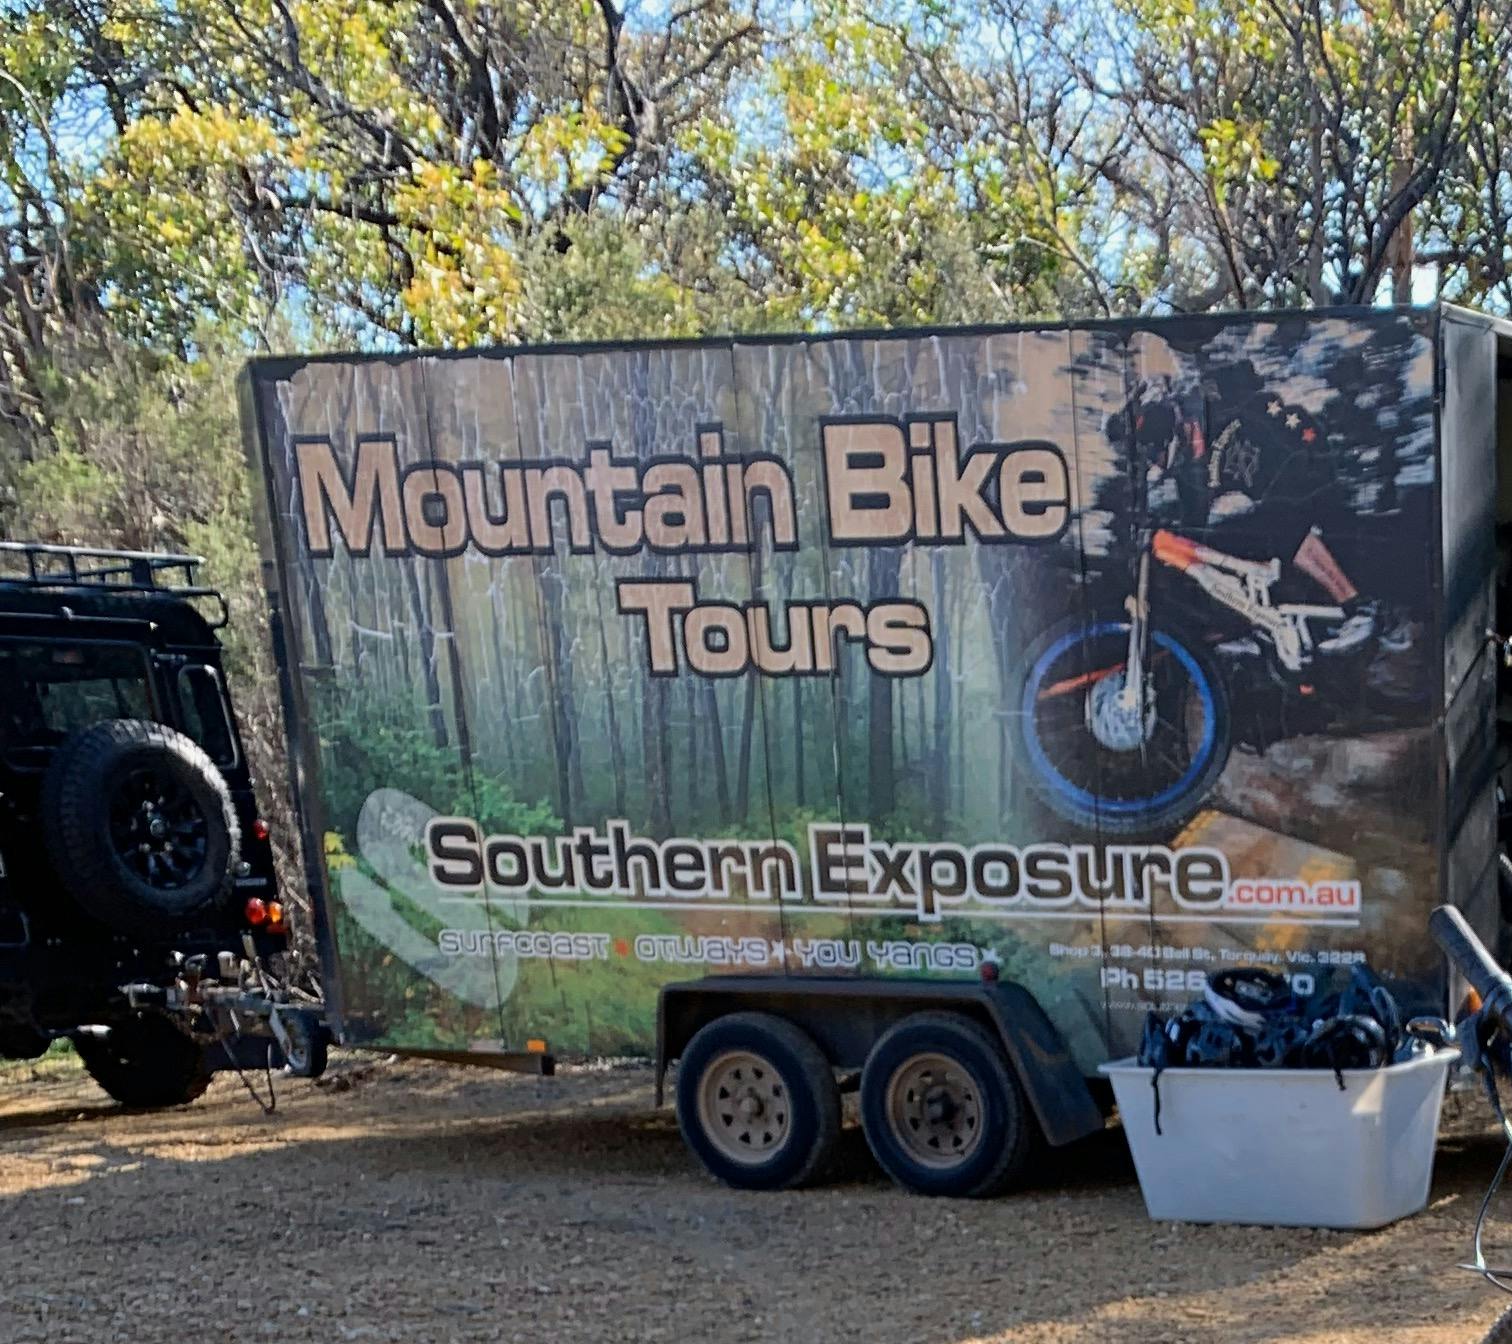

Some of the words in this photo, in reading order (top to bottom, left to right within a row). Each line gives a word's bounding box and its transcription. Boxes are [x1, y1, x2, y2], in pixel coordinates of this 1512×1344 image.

[292, 426, 798, 556] Mountain
[821, 415, 1070, 544] Bike
[617, 579, 931, 677] Tours
[427, 819, 799, 897] Southern
[1050, 942, 1088, 959] Shop
[1100, 967, 1138, 990] Ph
[1143, 967, 1207, 991] 526
